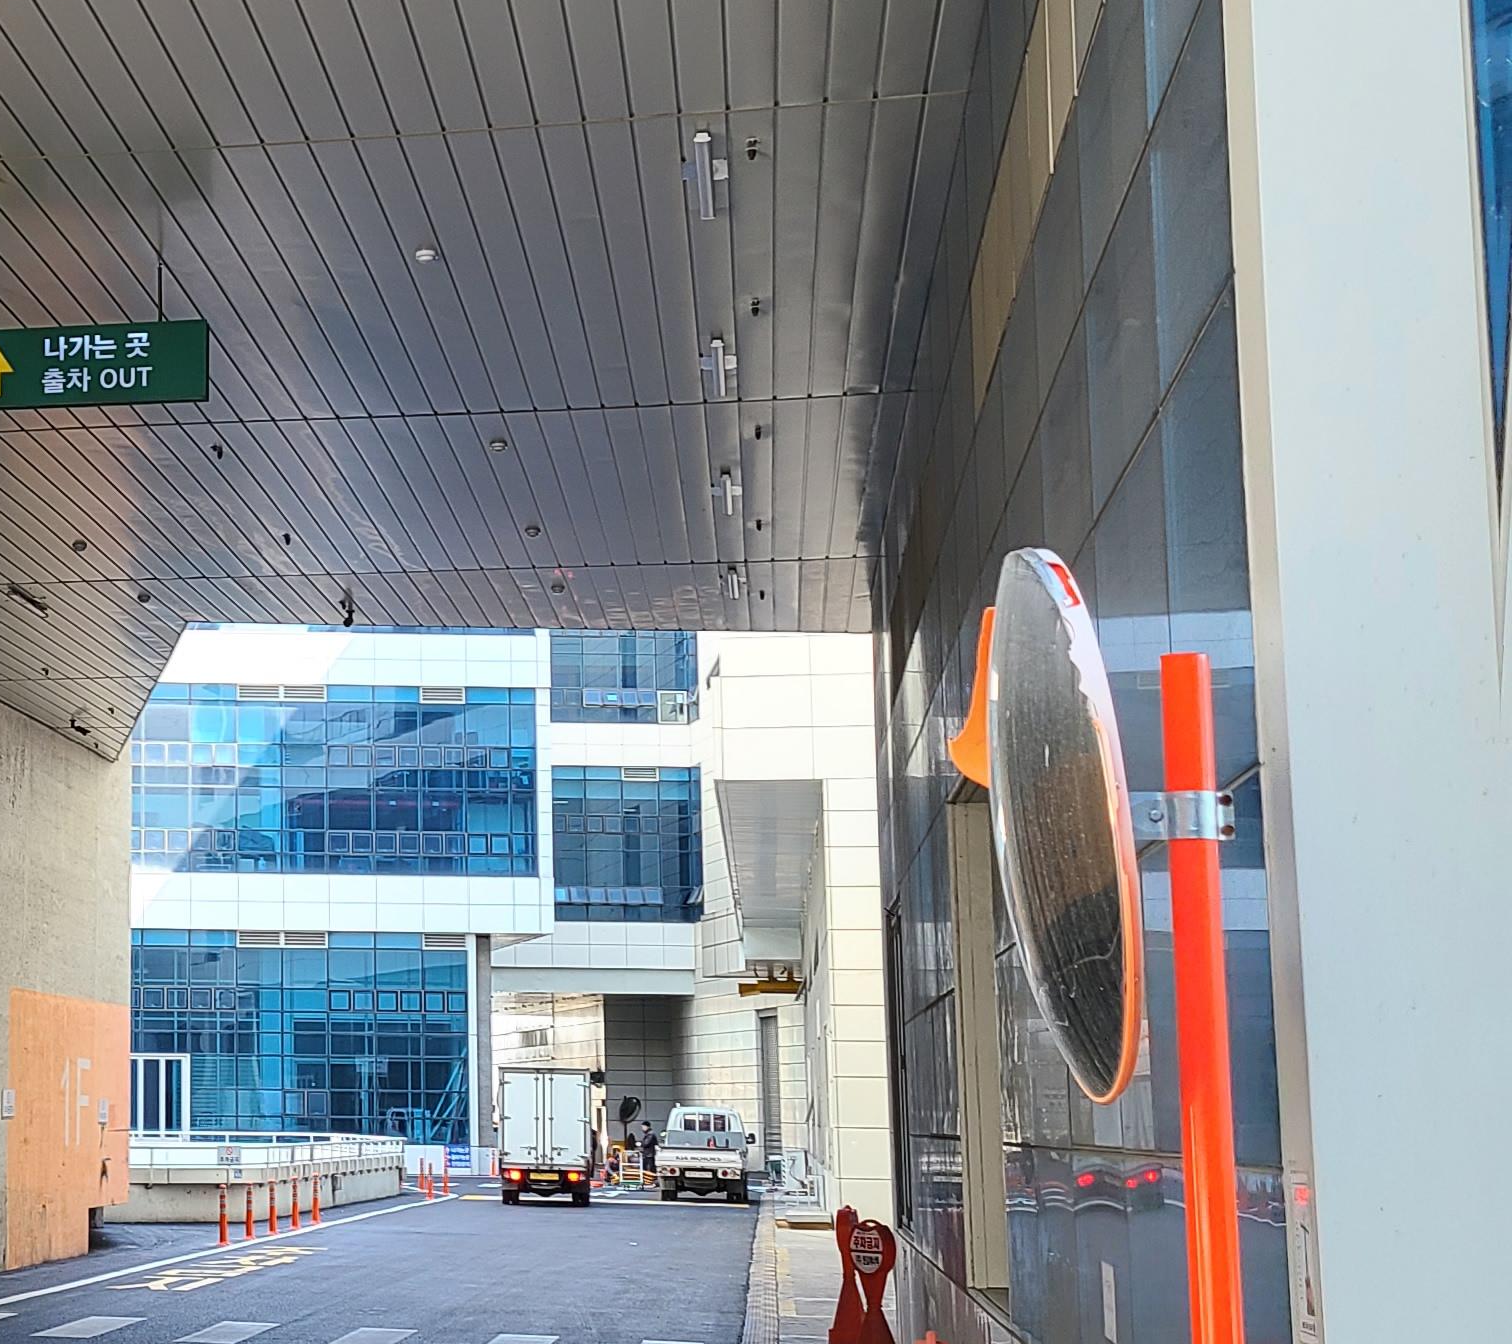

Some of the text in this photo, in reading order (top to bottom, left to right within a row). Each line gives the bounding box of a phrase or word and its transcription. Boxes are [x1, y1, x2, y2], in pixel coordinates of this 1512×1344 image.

[44, 332, 150, 361] 나가는 곳
[41, 366, 153, 394] 출차 OUT
